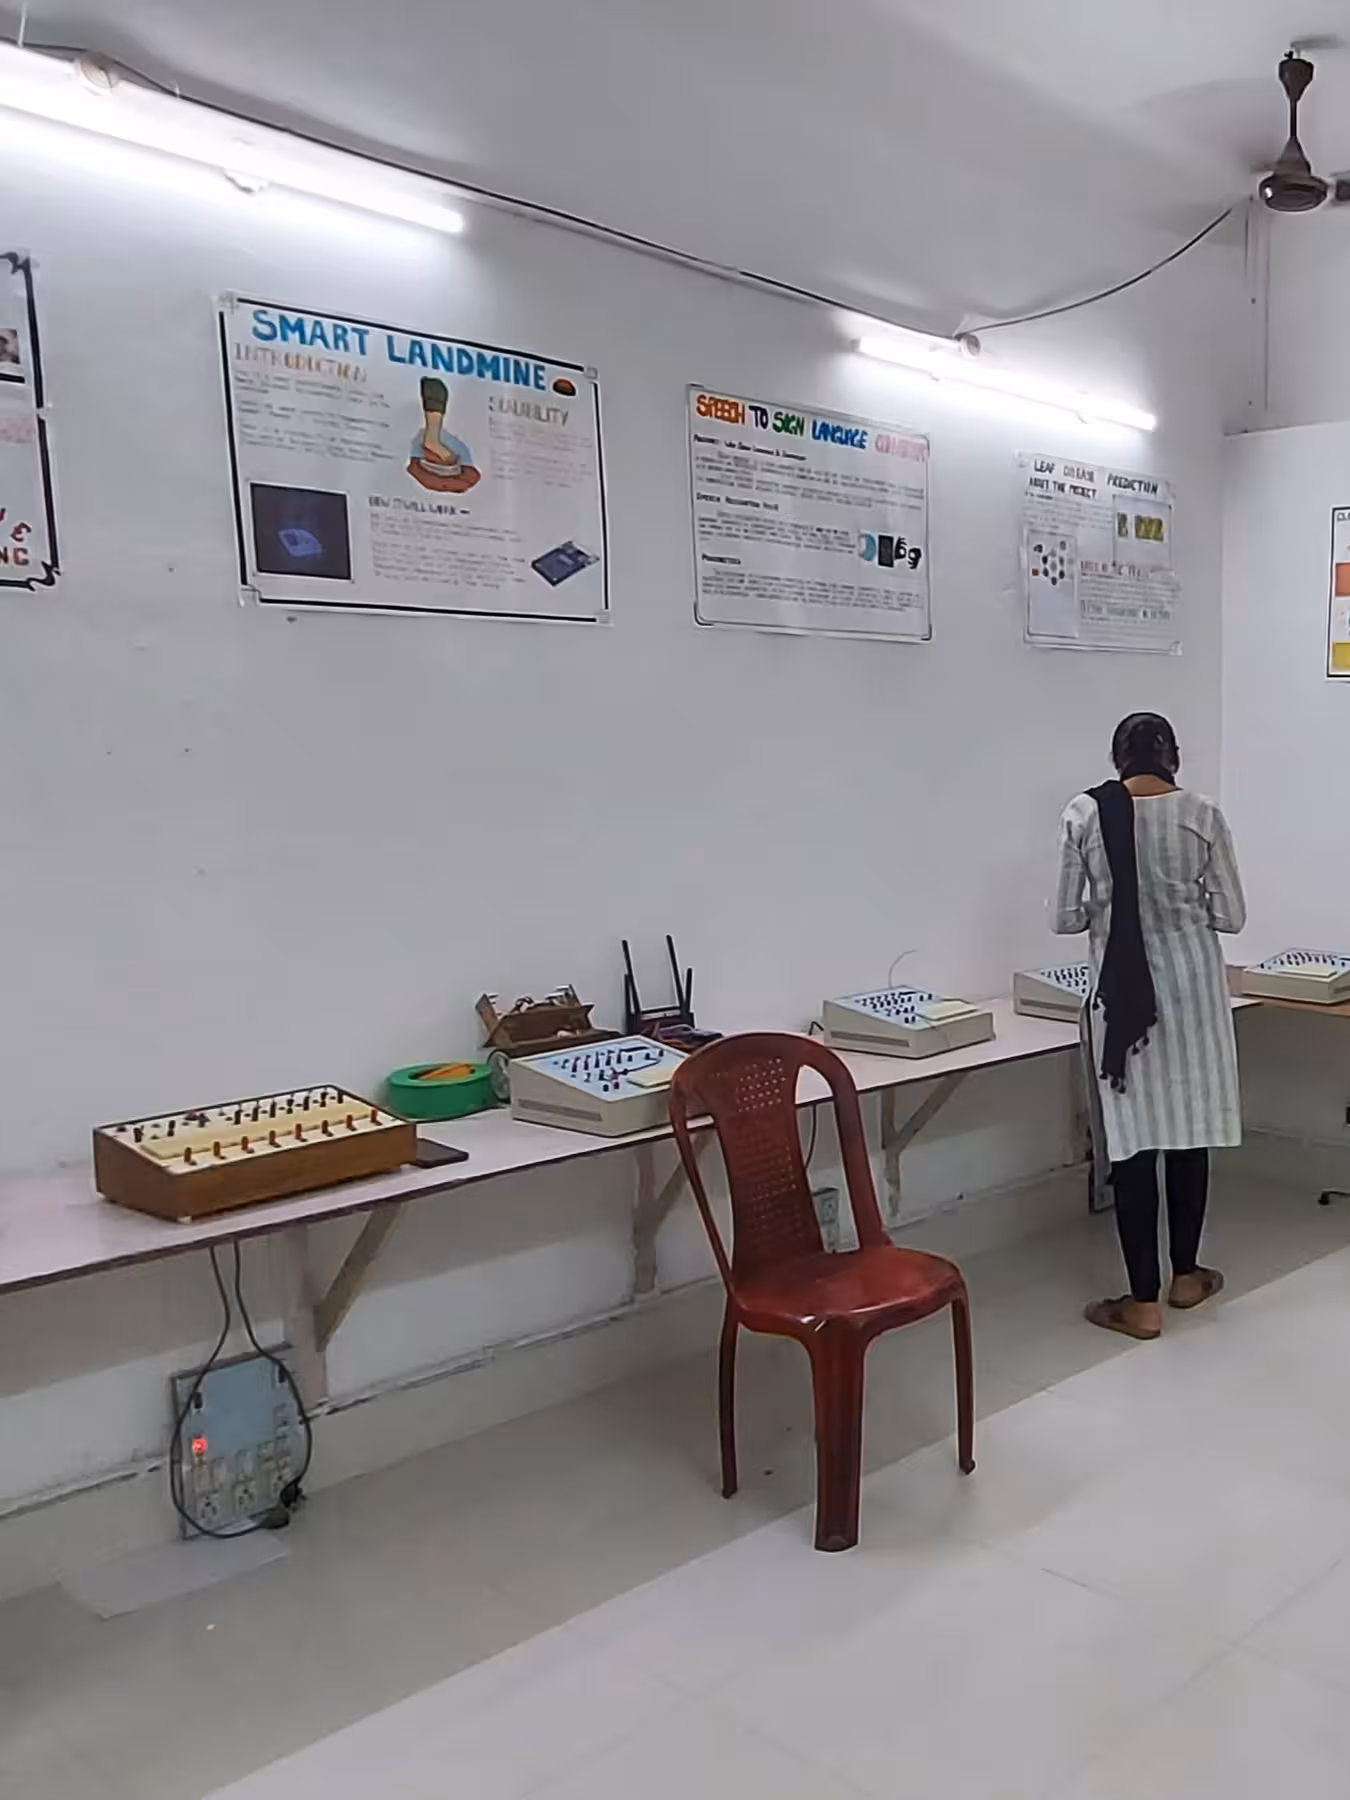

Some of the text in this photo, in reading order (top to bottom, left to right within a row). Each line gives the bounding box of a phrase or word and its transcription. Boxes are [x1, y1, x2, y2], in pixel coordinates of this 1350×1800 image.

[252, 309, 547, 391] SMART LANDMINE
[696, 394, 745, 425] SPEECH
[748, 404, 769, 430] TO
[772, 411, 805, 437] SIGN
[811, 418, 868, 450] LANGUAGE
[1033, 458, 1056, 474] LEAF
